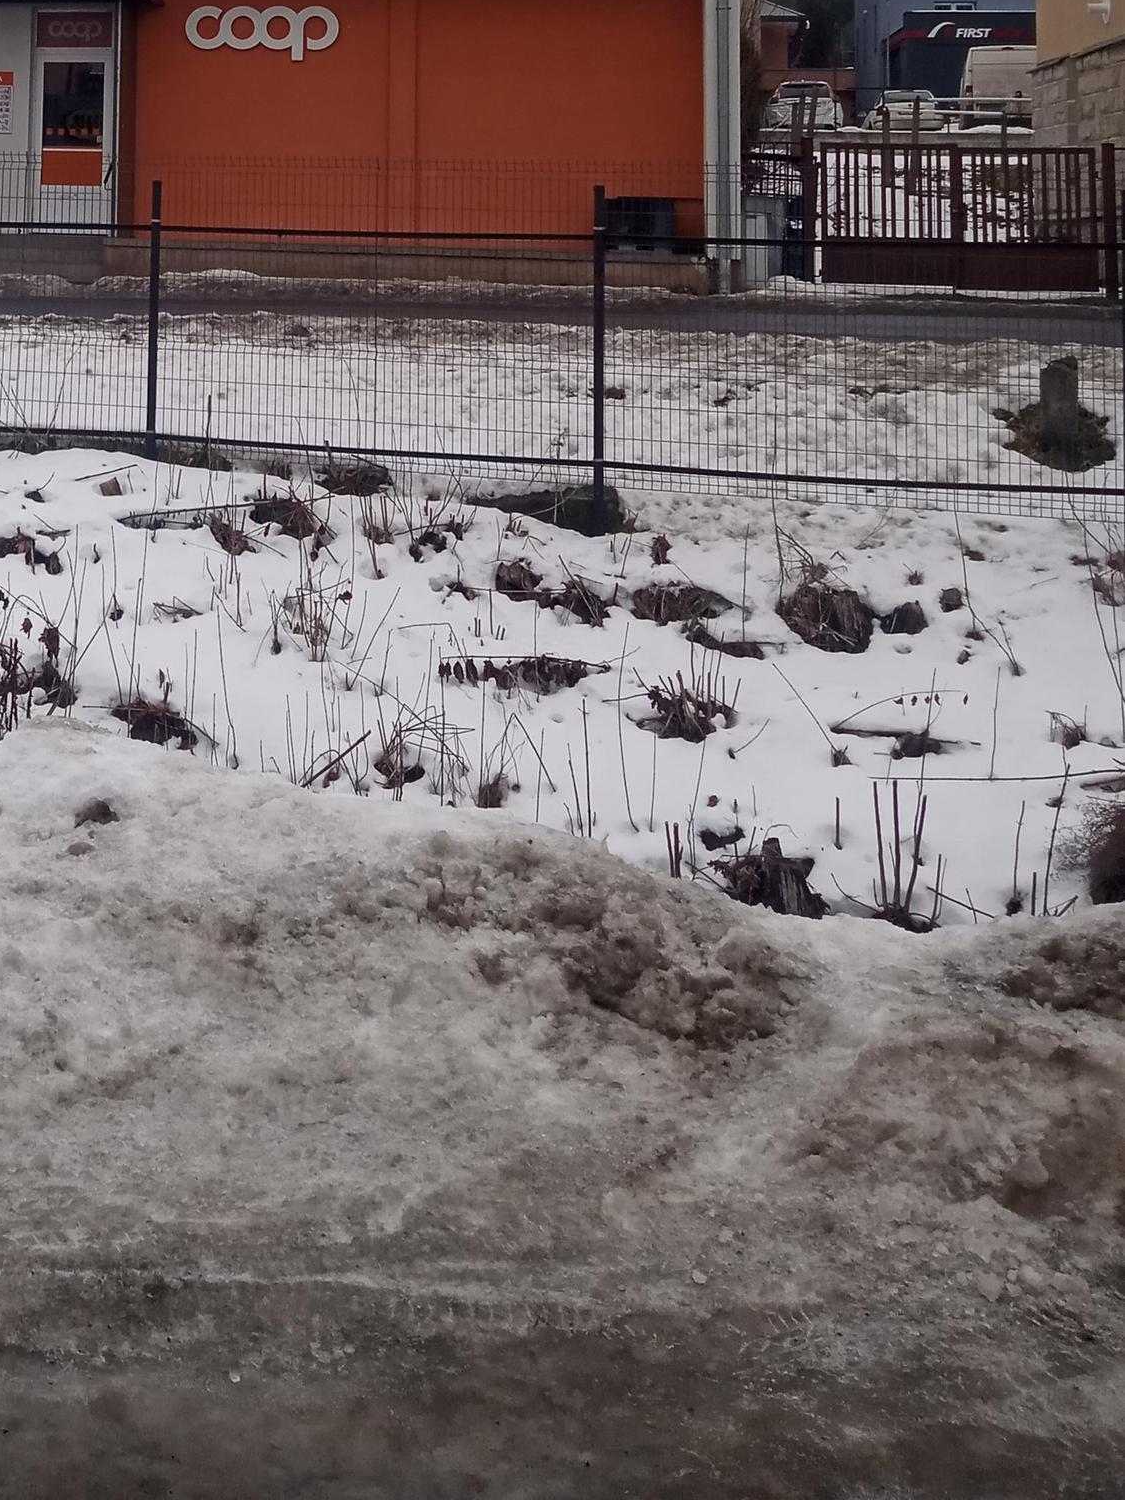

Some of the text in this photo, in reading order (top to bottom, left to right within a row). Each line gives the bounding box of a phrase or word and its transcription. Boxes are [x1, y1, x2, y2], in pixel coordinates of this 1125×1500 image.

[48, 20, 103, 42] coop
[185, 5, 339, 61] coop
[955, 28, 992, 38] FIRST
